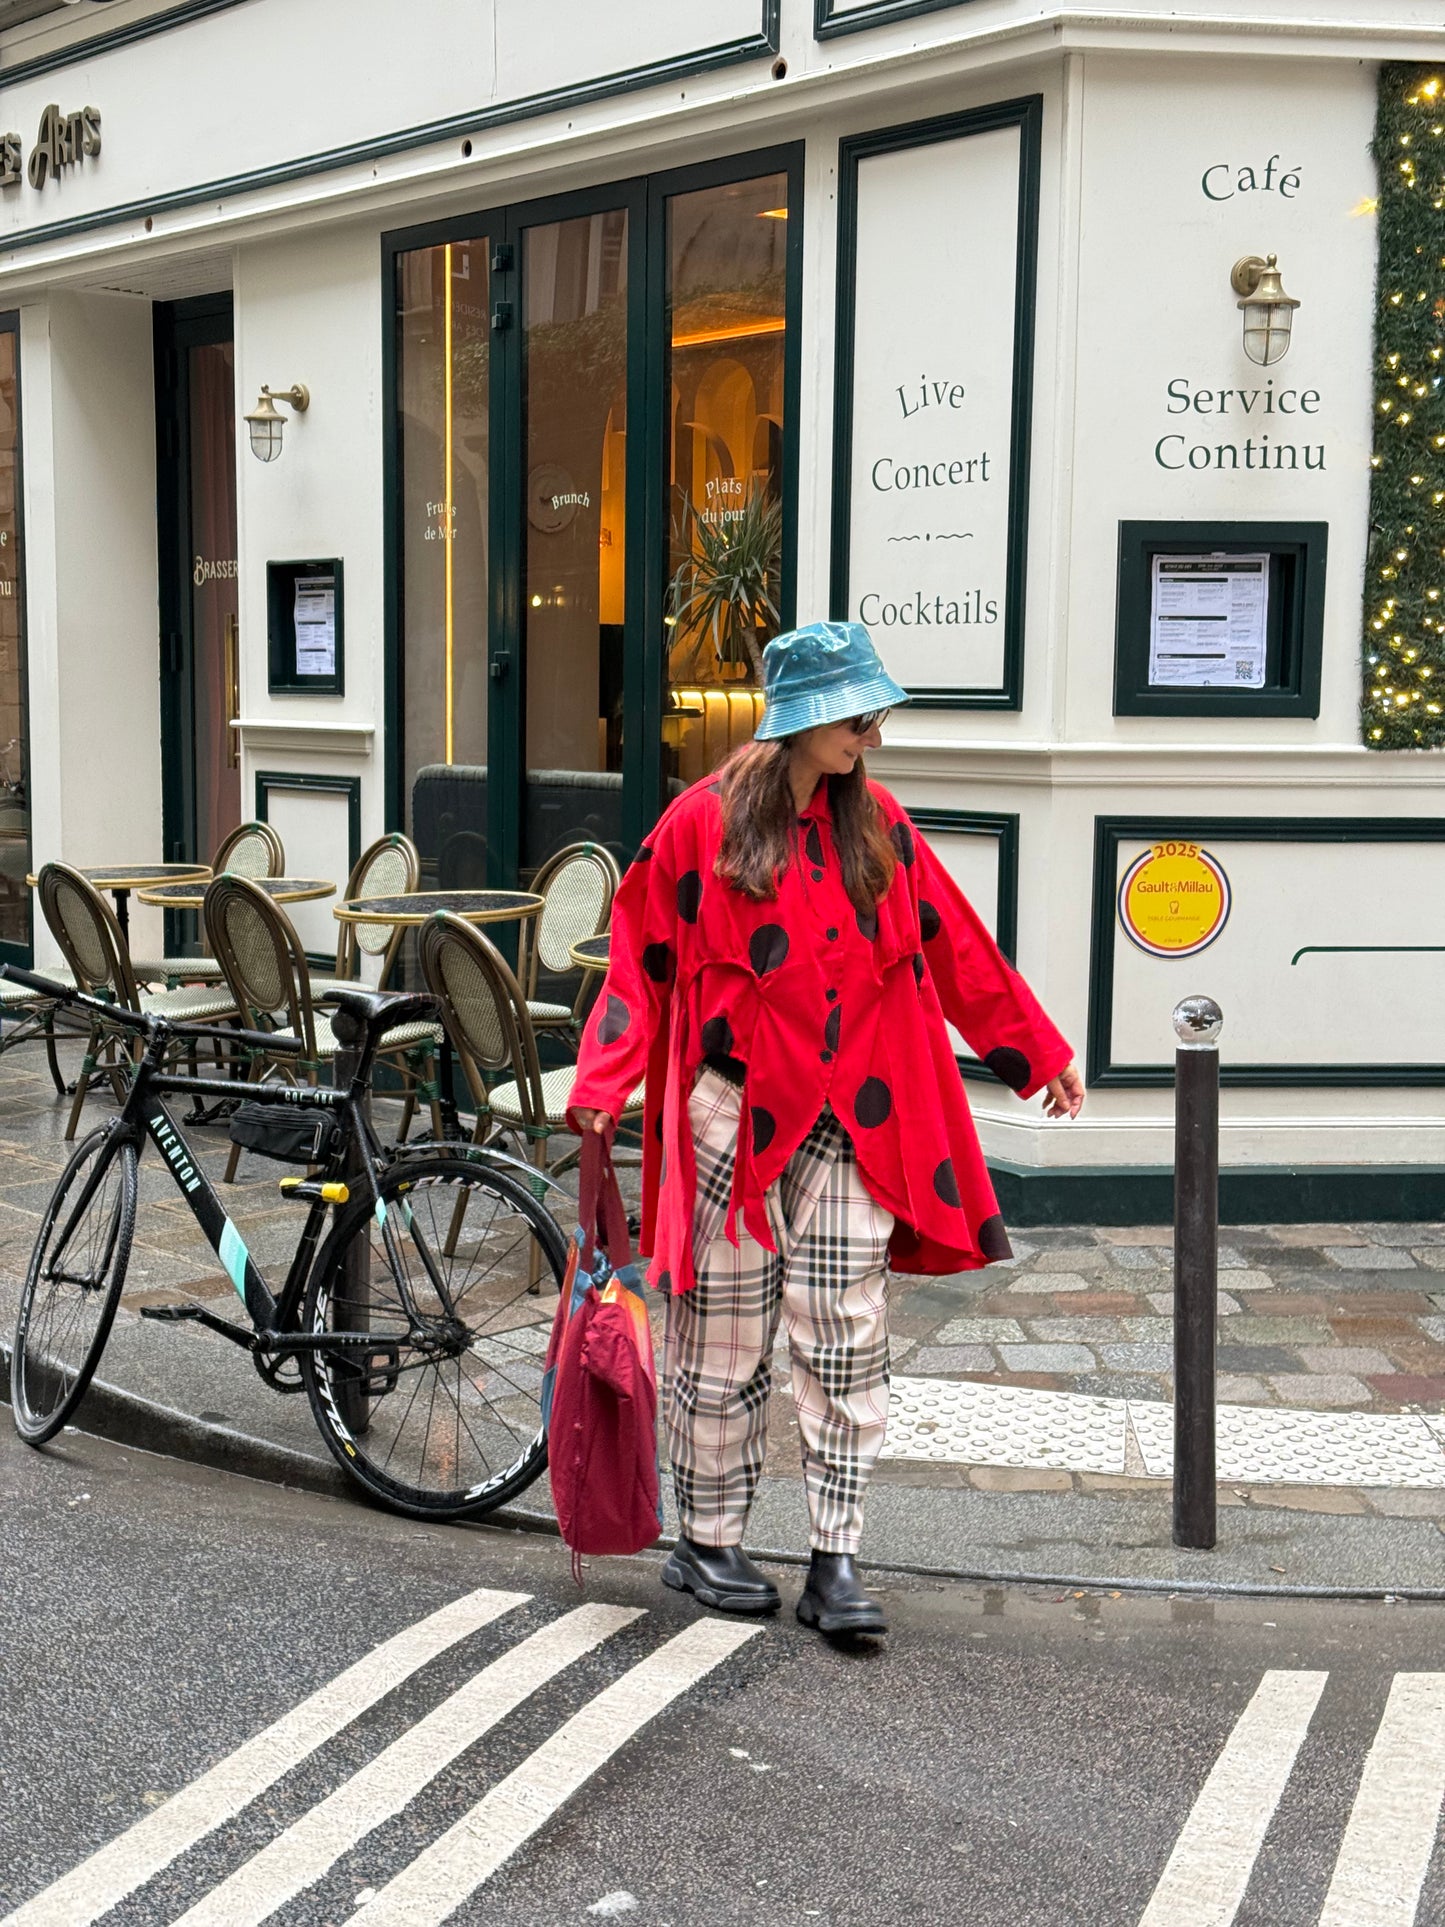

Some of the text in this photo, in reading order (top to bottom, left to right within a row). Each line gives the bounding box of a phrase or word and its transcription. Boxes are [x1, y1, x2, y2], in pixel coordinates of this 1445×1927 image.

[28, 104, 101, 190] ARTS
[1202, 154, 1302, 201] Café
[895, 374, 965, 419] Live
[1167, 378, 1320, 414] Service
[1155, 435, 1326, 470] Continu
[705, 477, 742, 499] Plats
[872, 451, 990, 491] Concert
[426, 501, 457, 517] Fruis
[551, 491, 590, 510] Brunch
[701, 507, 745, 528] du jour
[424, 525, 436, 540] de
[859, 589, 998, 626] Cocktails
[1154, 842, 1198, 859] 2025
[1137, 881, 1213, 893] Gault&Millau
[150, 1115, 201, 1193] AVENTON
